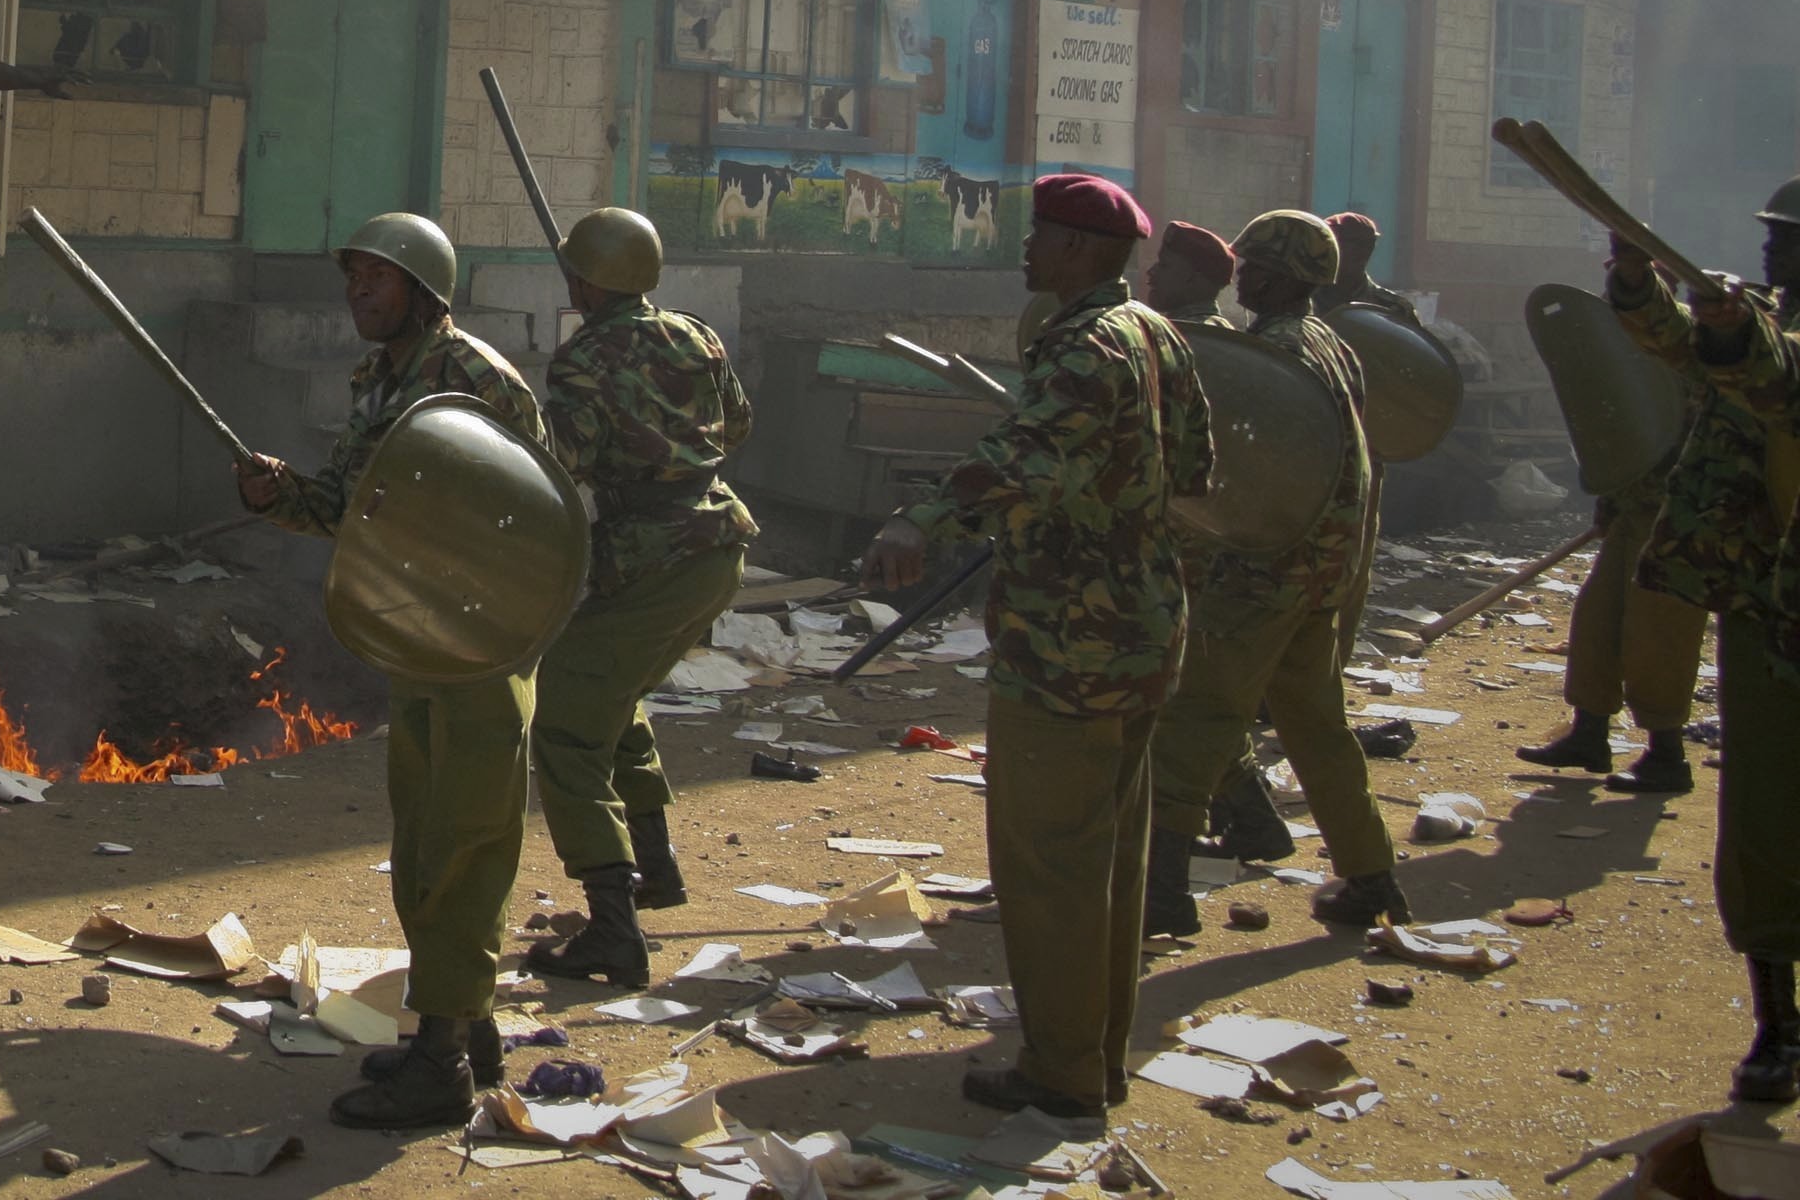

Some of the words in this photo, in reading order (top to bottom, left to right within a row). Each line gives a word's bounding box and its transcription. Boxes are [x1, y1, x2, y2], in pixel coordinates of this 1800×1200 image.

[1066, 4, 1085, 22] We
[1061, 38, 1101, 64] SCRATCH
[1102, 40, 1134, 66] CARDS
[1057, 76, 1097, 102] COOKING
[1100, 79, 1123, 104] GAS
[1056, 120, 1082, 144] EGGS
